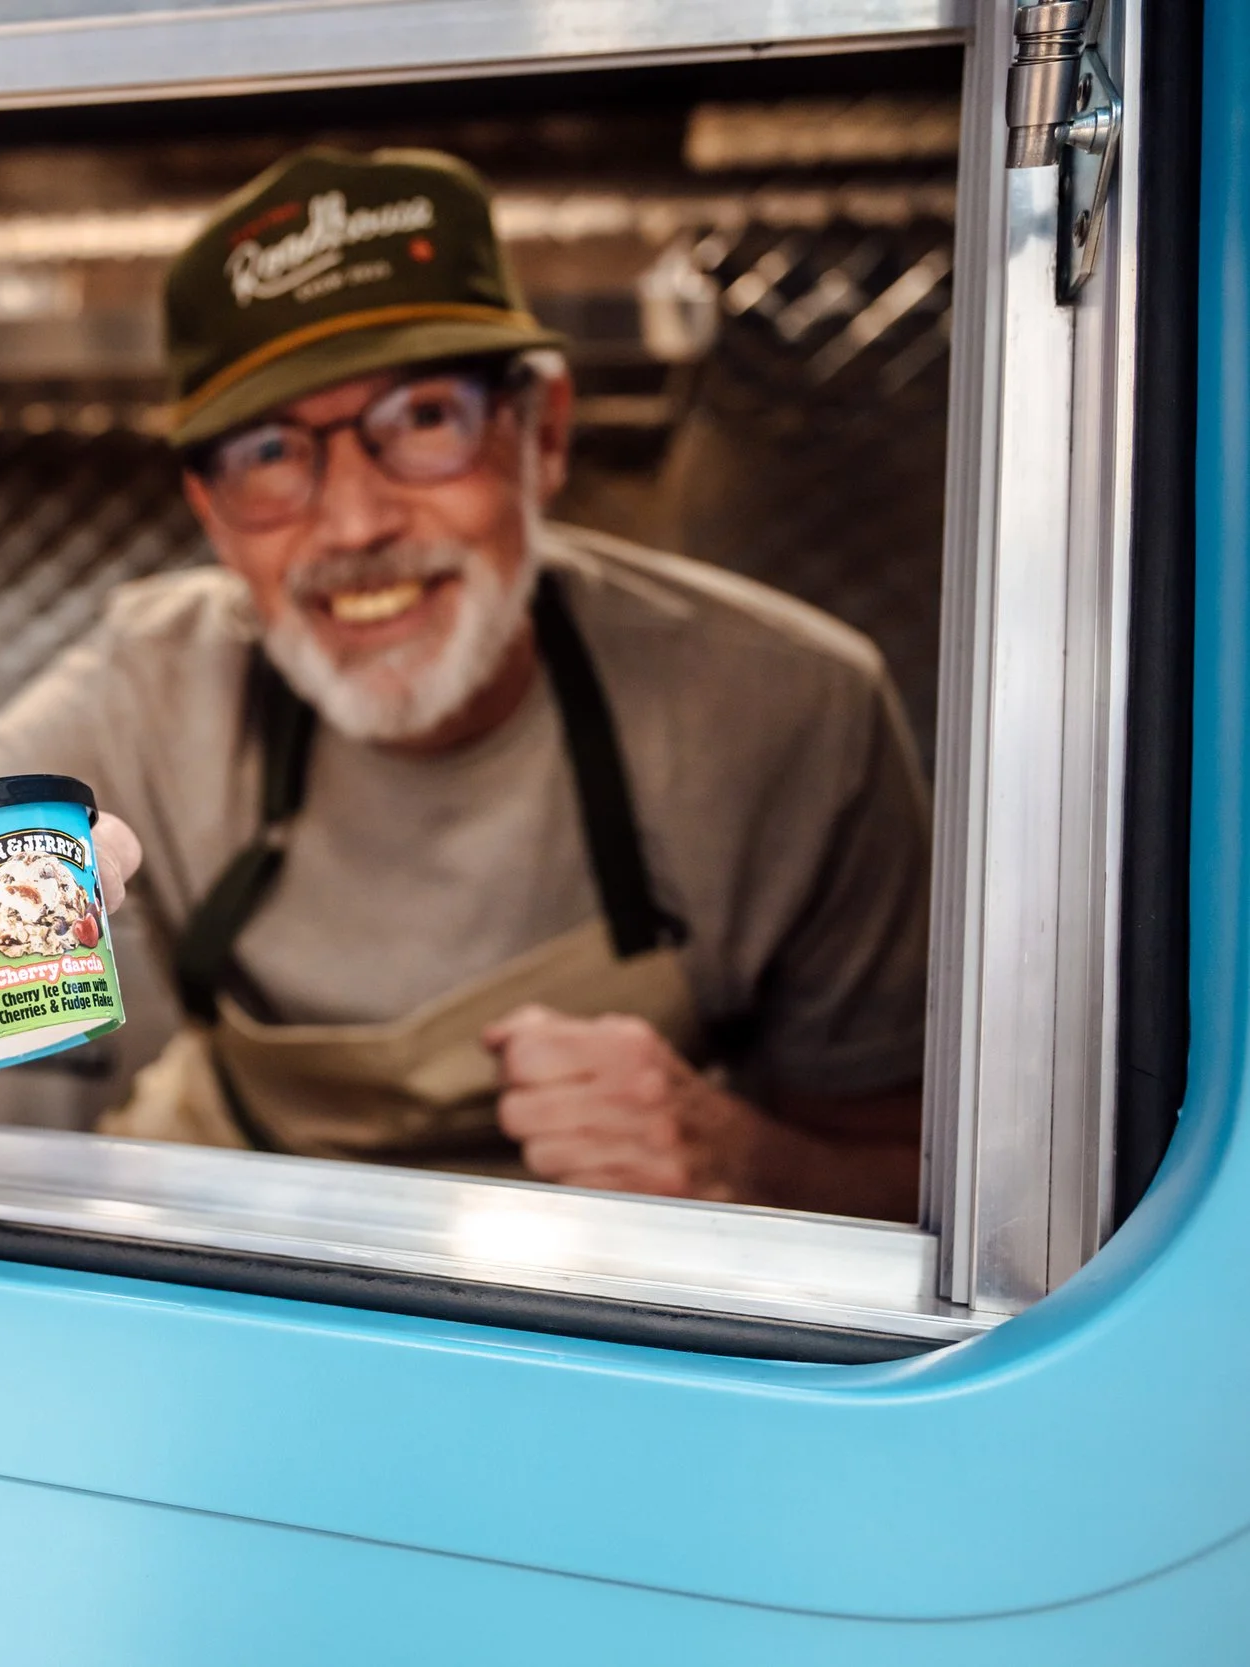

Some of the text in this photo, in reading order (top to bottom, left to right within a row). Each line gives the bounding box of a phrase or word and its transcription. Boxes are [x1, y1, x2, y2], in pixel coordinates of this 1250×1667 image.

[23, 835, 82, 864] JERRY'S
[61, 954, 104, 974] Garcia
[2, 978, 109, 1008] Cherry Ice Cream with
[49, 999, 60, 1014] &
[61, 995, 91, 1012] Fudge
[92, 993, 114, 1008] Flakes
